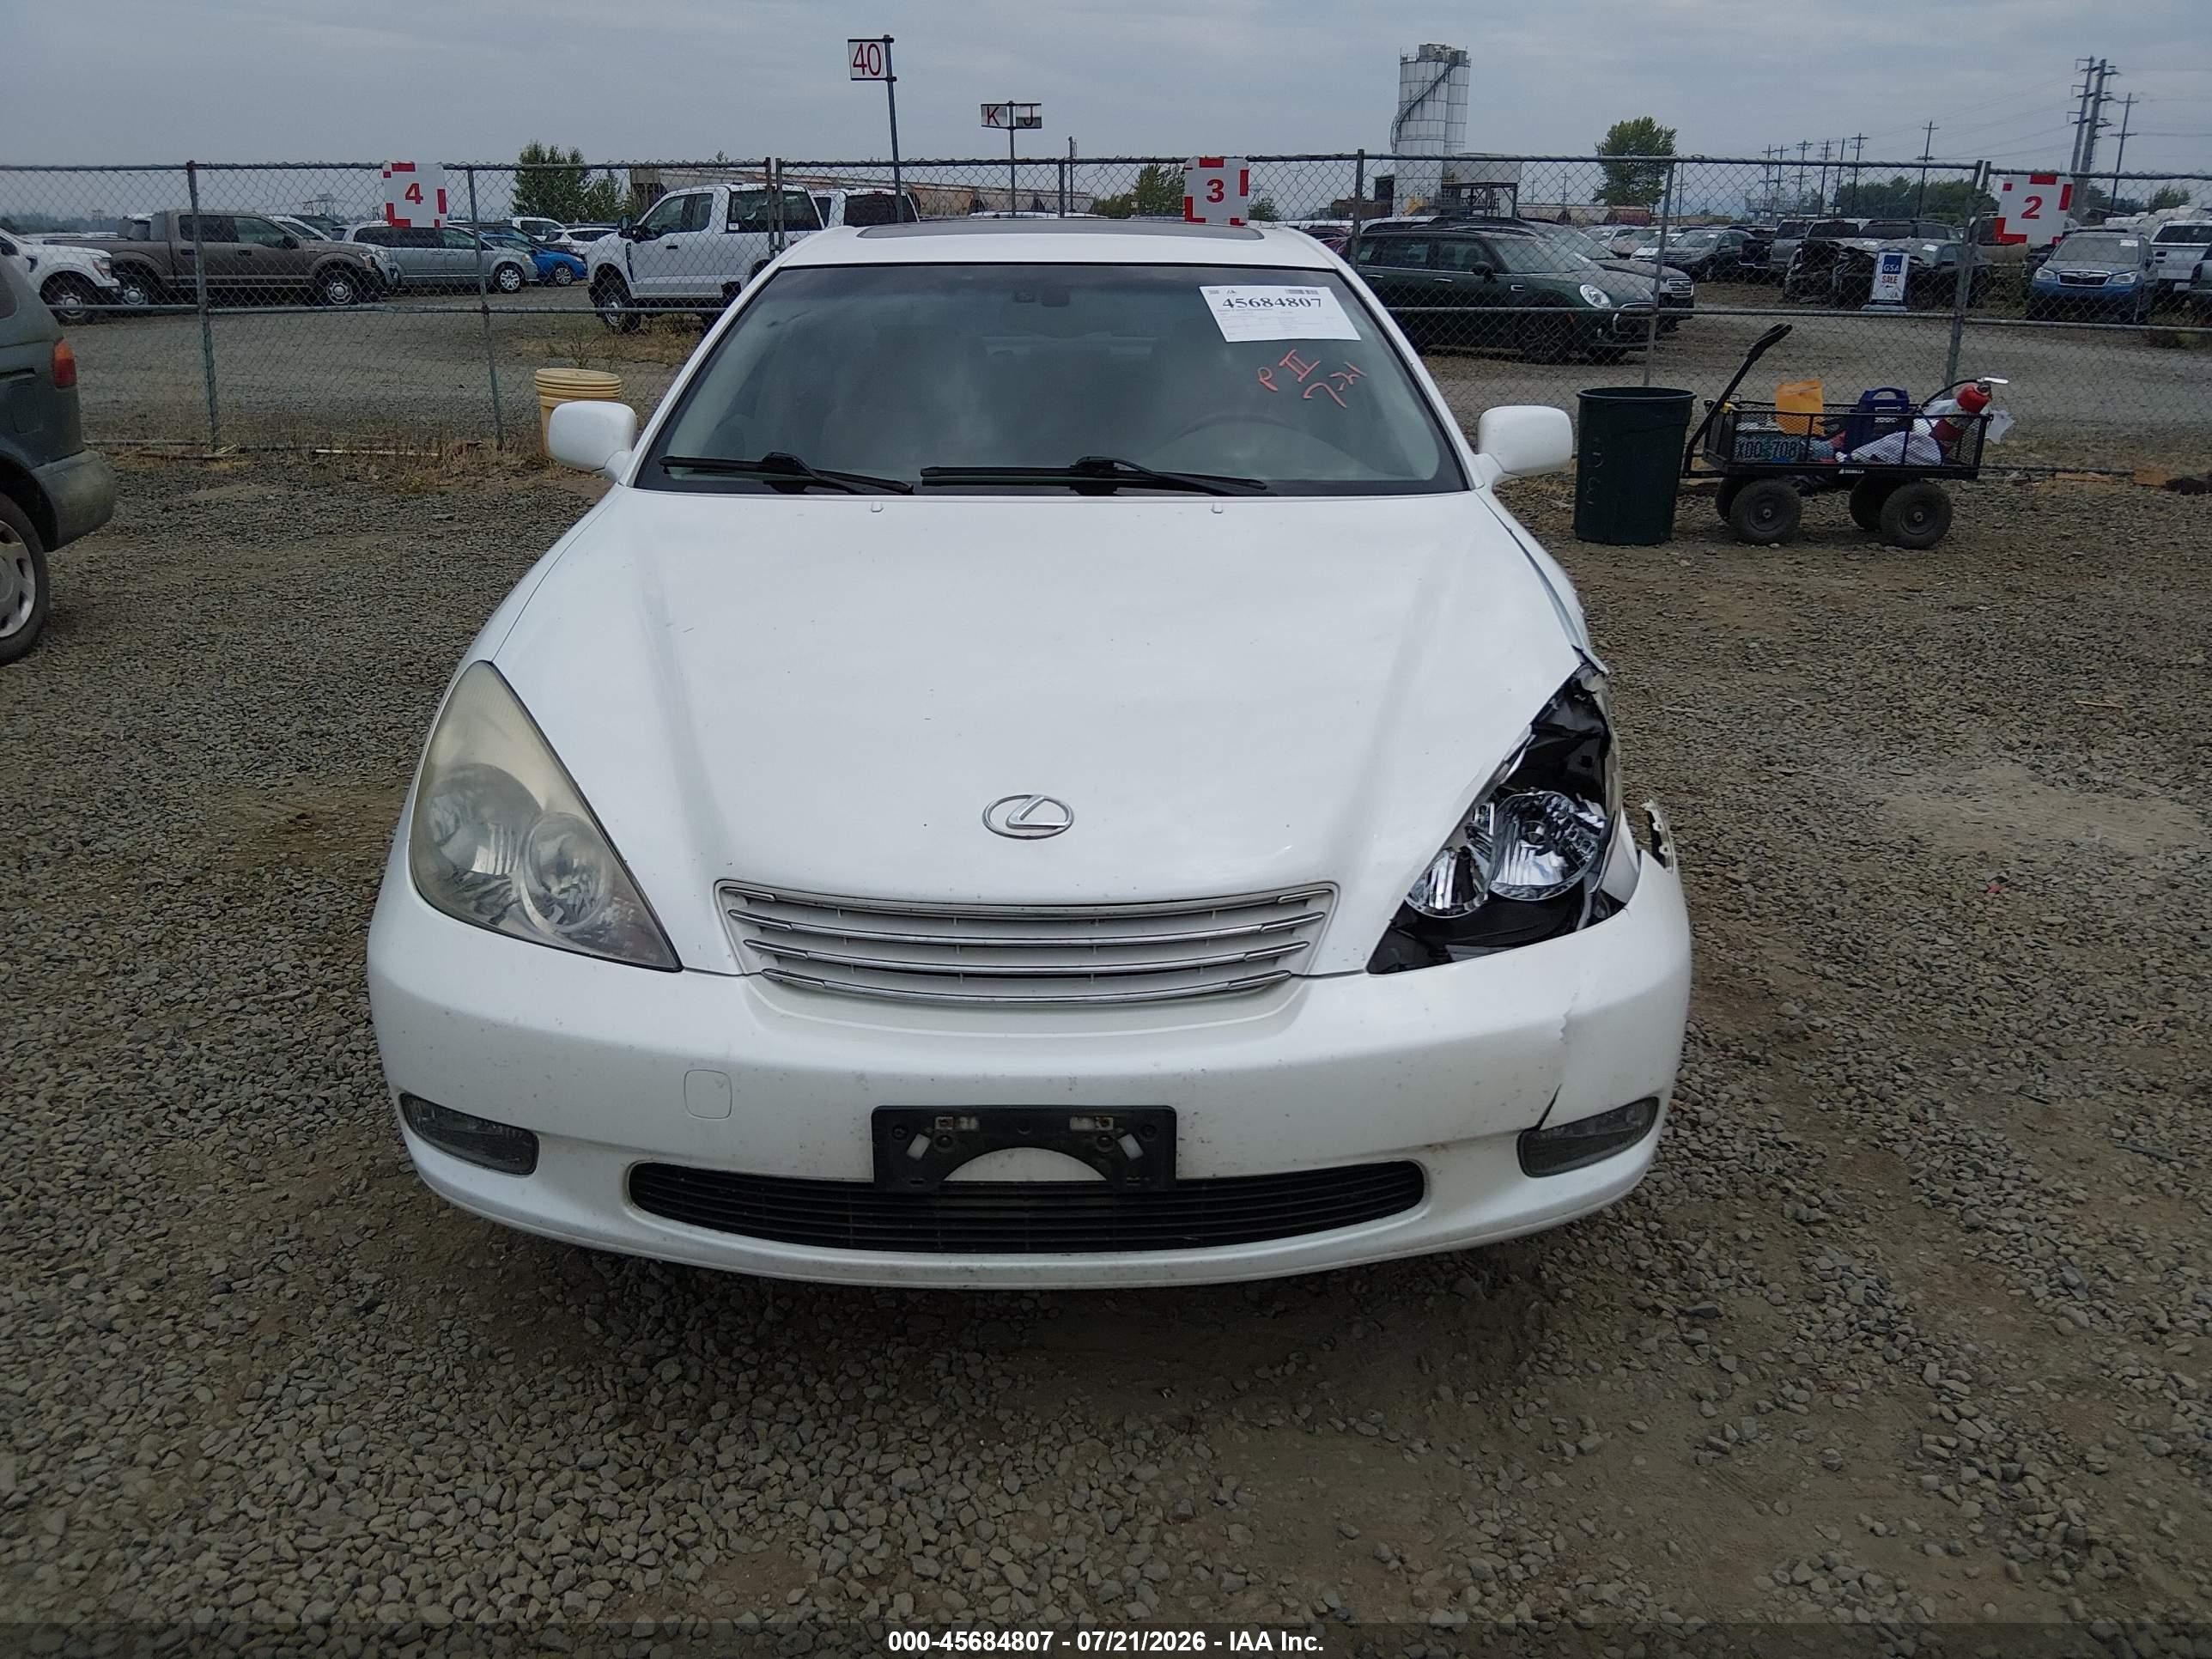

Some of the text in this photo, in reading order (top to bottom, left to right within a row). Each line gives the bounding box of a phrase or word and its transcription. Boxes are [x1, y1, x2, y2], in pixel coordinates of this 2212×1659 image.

[852, 43, 882, 76] 40
[986, 106, 1000, 126] K
[1023, 106, 1034, 126] J
[404, 182, 424, 205] 4
[1206, 179, 1224, 204] 3
[2021, 195, 2043, 220] 2
[1883, 264, 1900, 272] GSA
[1881, 275, 1899, 284] SALE
[1222, 296, 1322, 309] 45684807
[1771, 441, 1798, 459] 708
